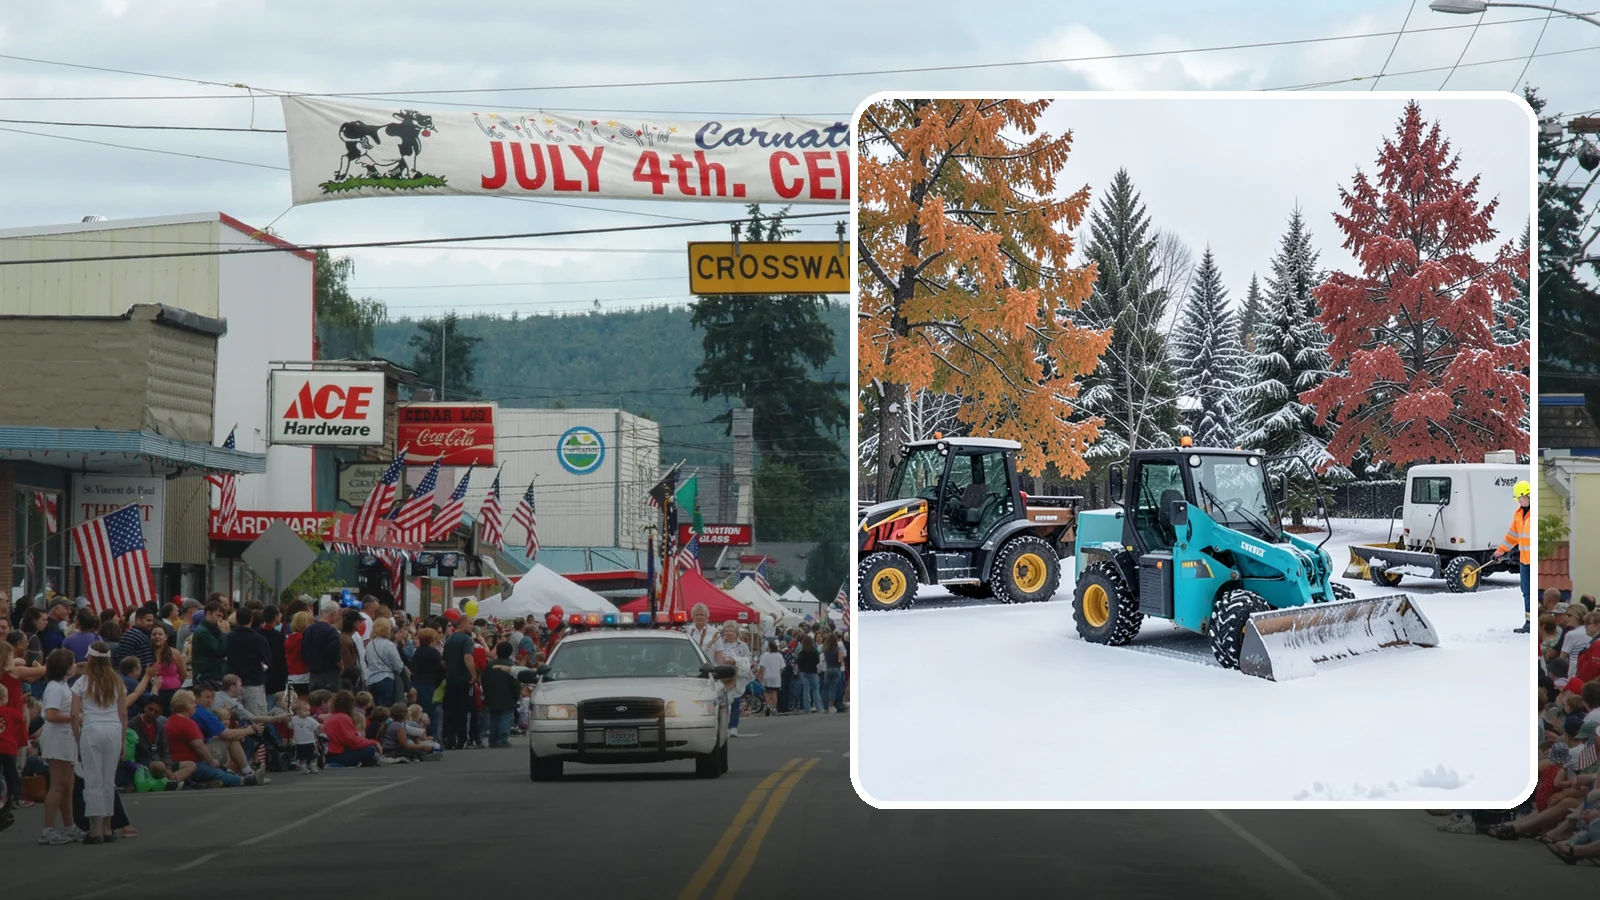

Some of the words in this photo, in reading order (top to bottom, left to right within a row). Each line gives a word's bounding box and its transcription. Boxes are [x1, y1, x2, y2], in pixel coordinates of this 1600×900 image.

[481, 141, 605, 192] JULY
[632, 150, 746, 198] 4th.
[696, 254, 850, 280] CROSSWA
[282, 380, 374, 420] ACE
[405, 409, 453, 422] CEDAR
[283, 421, 371, 437] Hardware
[416, 428, 477, 447] Coca-Cola
[353, 467, 388, 479] Simpl
[95, 484, 124, 495] Vincent
[126, 486, 136, 494] de
[138, 486, 155, 495] Paul
[212, 516, 330, 536] HARDARE
[688, 526, 741, 535] CRNATION
[699, 535, 730, 543] GLASS
